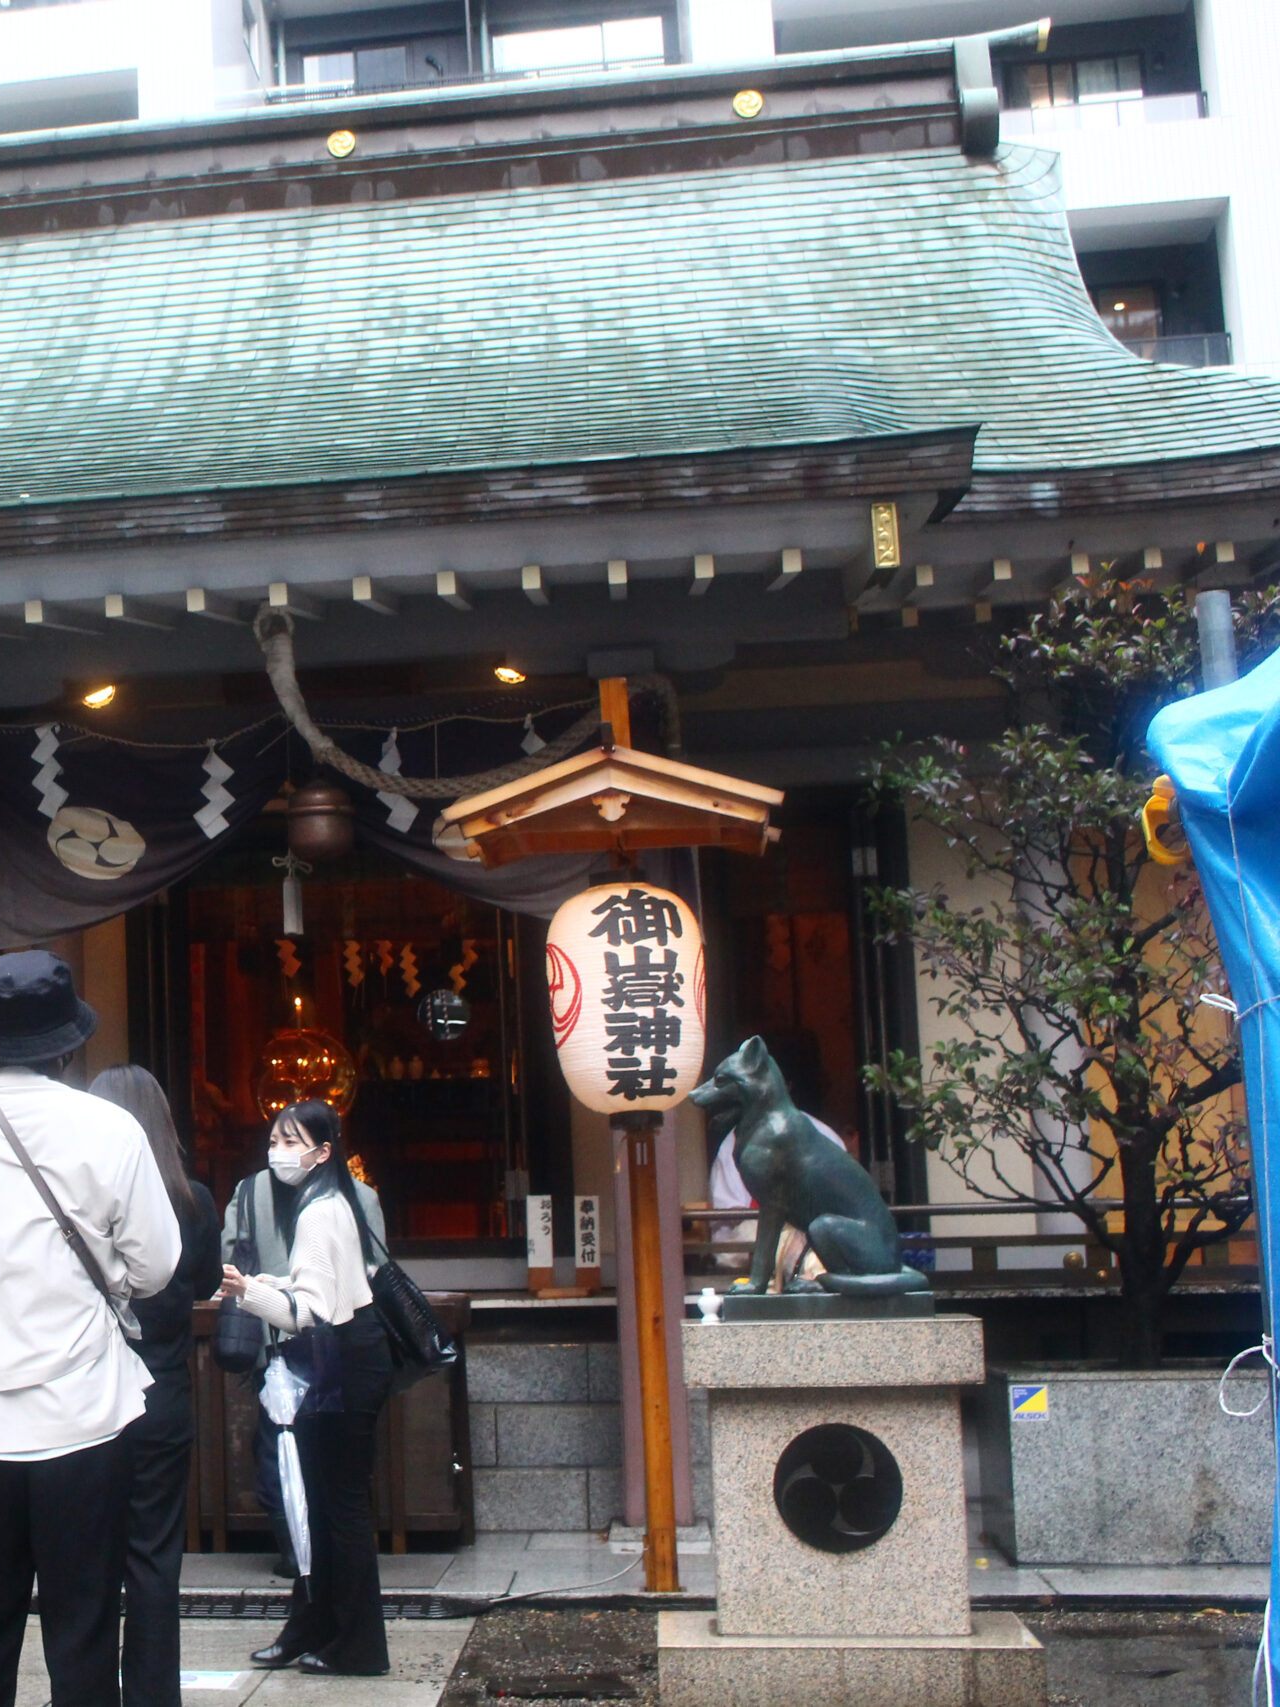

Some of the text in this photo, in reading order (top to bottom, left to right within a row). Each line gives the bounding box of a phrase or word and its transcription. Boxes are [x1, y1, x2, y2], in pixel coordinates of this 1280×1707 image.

[588, 889, 686, 1101] 御嶽神社
[580, 1199, 597, 1264] 奉納受付
